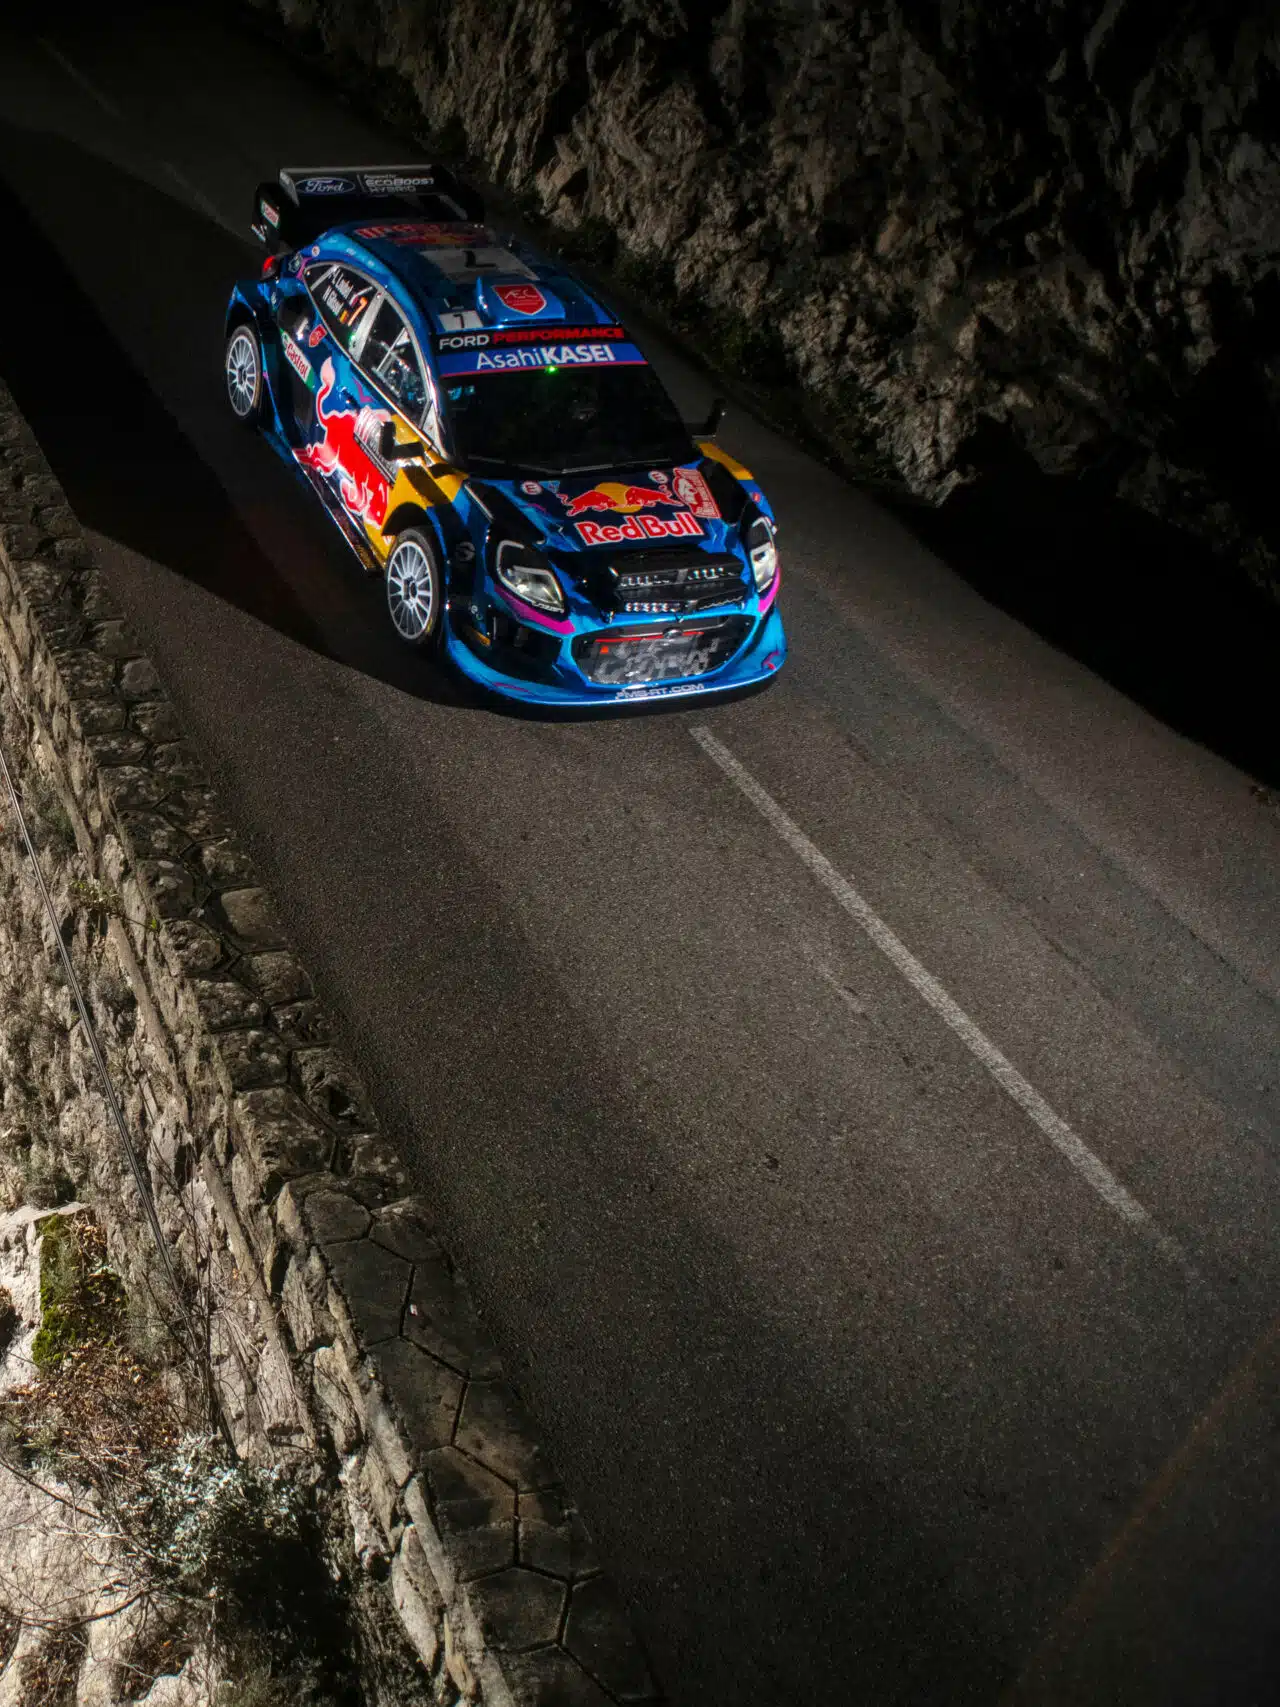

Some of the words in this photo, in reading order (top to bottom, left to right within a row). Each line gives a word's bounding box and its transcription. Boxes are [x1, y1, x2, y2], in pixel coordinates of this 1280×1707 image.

[304, 179, 345, 193] Ford
[439, 334, 490, 350] FORD
[493, 327, 625, 344] PERFORMANCE
[575, 516, 642, 546] Red
[640, 512, 704, 539] Bull
